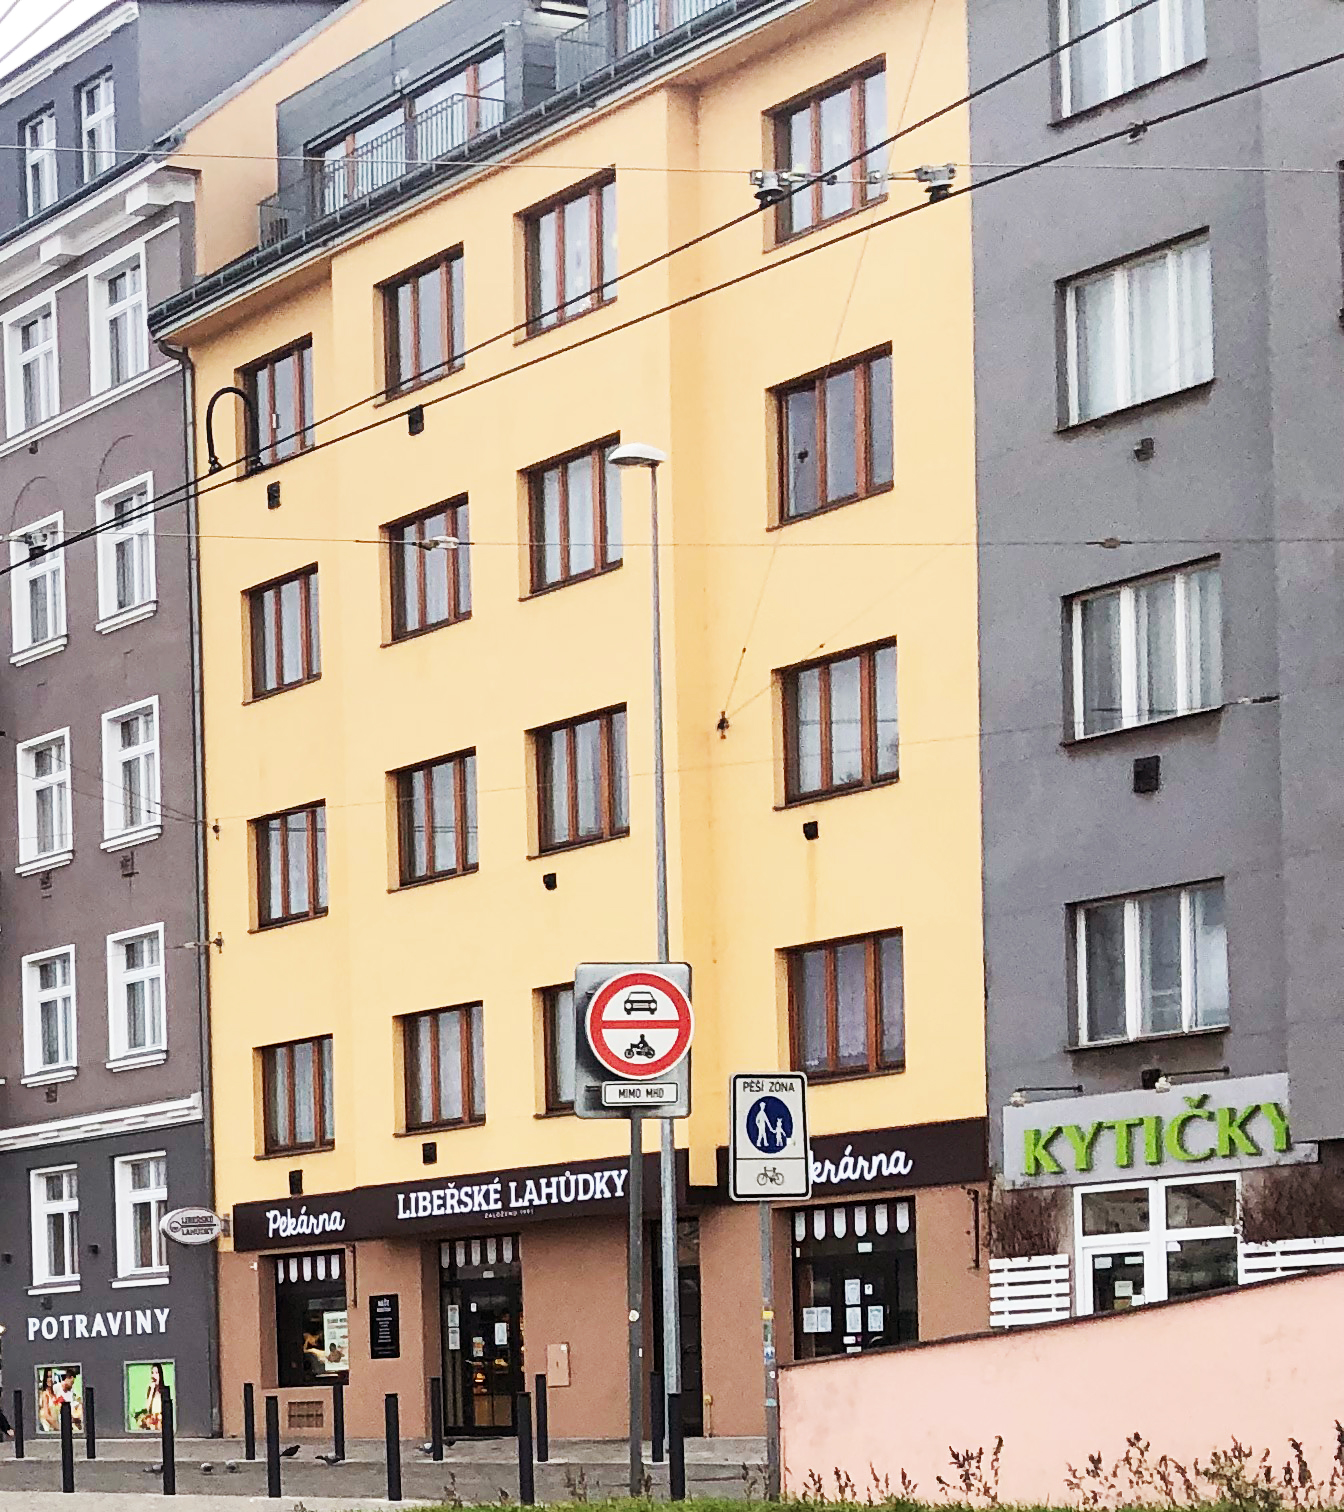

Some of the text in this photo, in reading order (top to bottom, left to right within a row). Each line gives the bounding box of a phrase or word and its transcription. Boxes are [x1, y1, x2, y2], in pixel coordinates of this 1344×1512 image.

[618, 1087, 664, 1099] MIMO MHD
[743, 1079, 795, 1093] PĚŠÍ ZÓNA
[1023, 1094, 1291, 1176] KYTIČKY
[809, 1144, 913, 1184] krárna
[397, 1169, 629, 1219] LIBEŘSKÉ LAHŮDKY
[266, 1206, 346, 1238] Pekárna
[27, 1308, 170, 1341] POTRAVINY
